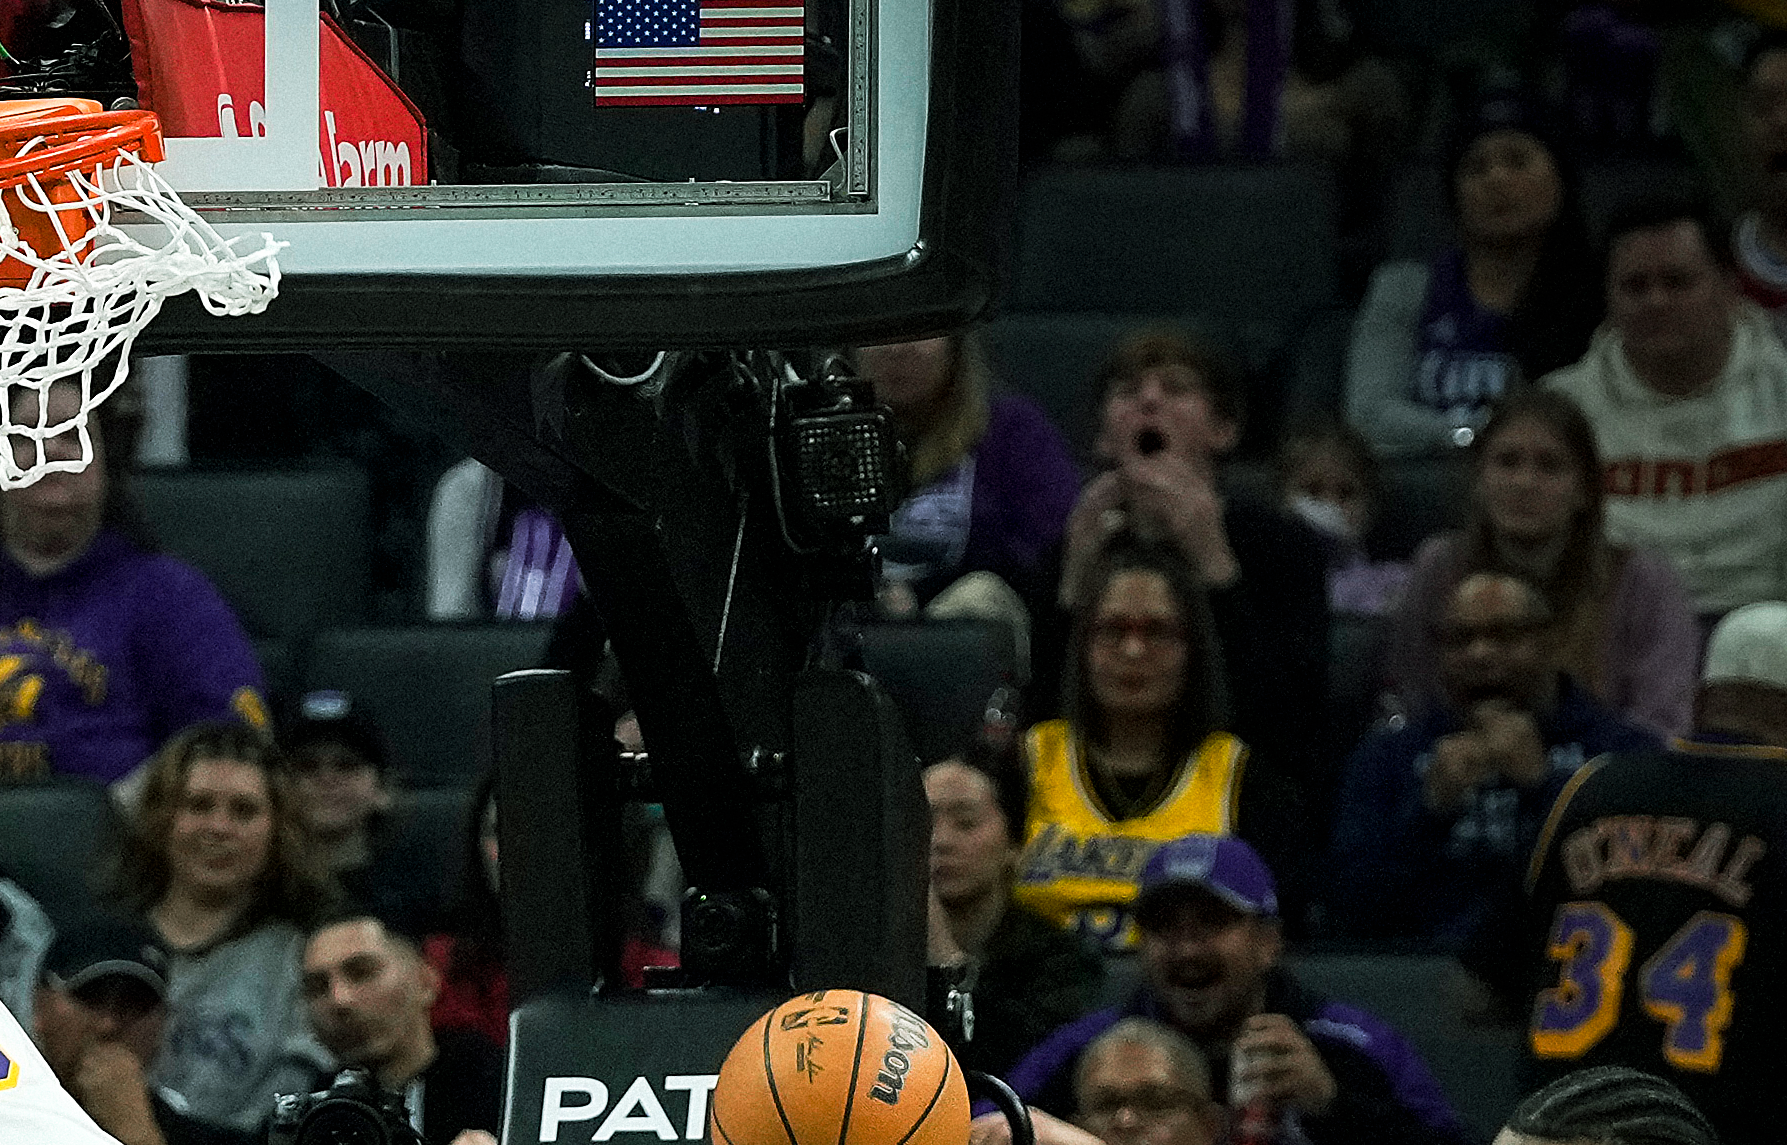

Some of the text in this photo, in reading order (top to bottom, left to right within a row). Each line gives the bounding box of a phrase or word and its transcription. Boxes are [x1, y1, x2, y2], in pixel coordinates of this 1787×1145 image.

[319, 110, 412, 188] larm
[1530, 901, 1751, 1076] 34
[539, 1074, 721, 1142] PAT
